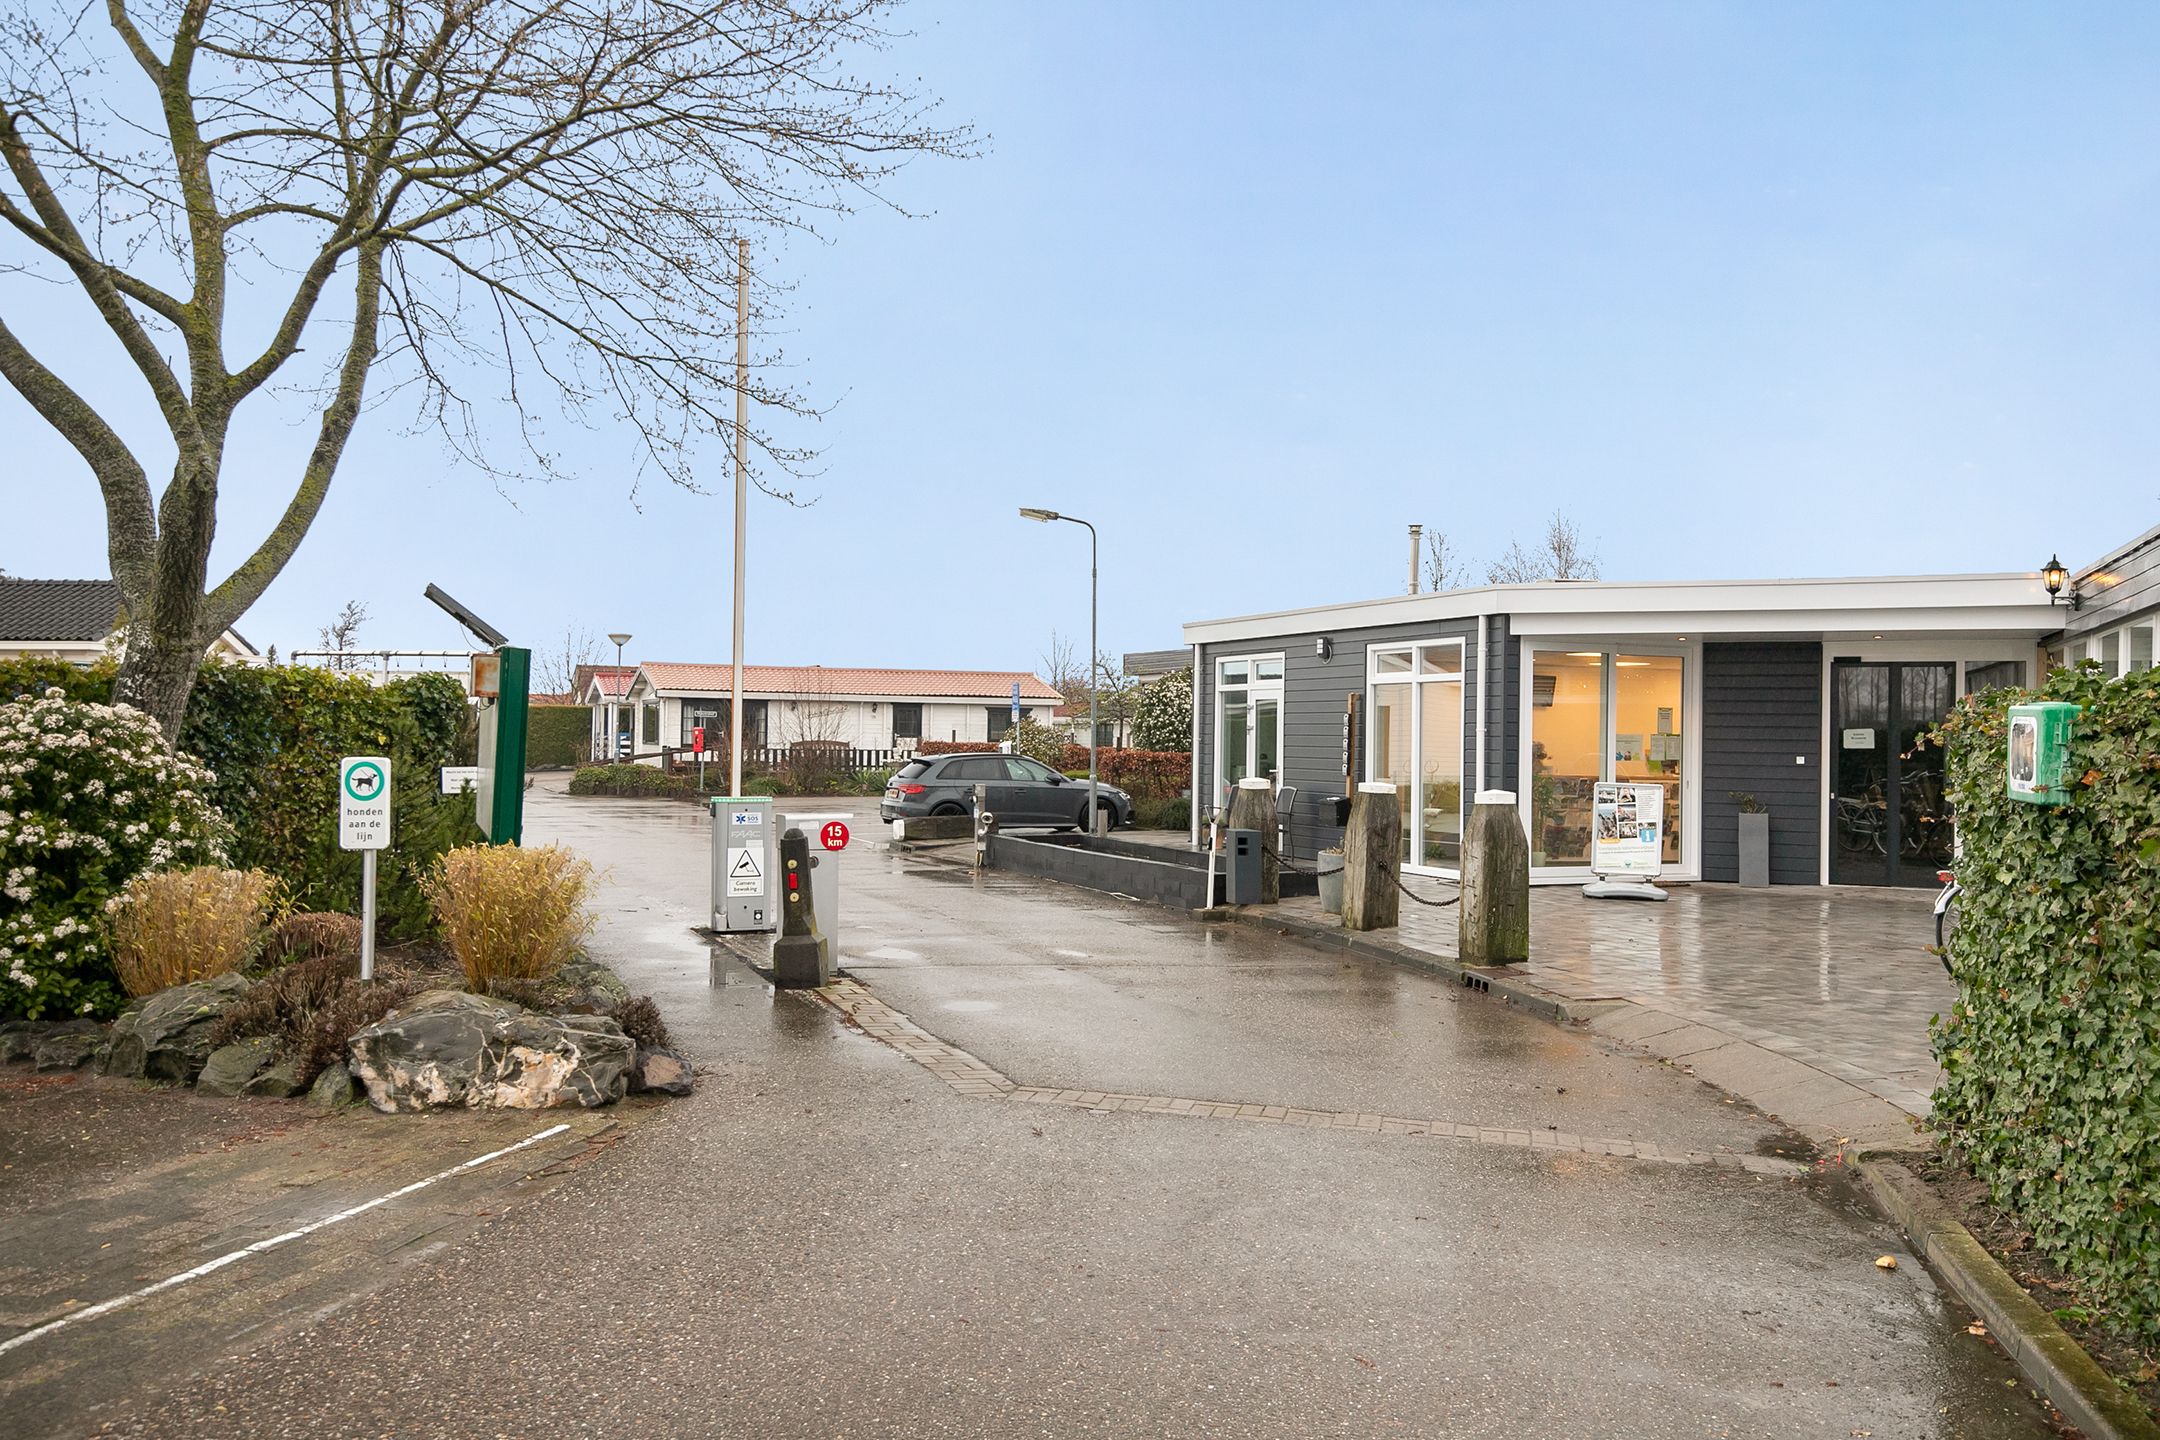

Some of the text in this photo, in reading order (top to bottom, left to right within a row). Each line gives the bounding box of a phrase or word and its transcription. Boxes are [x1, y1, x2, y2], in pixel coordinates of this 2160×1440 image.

[347, 808, 383, 816] honden
[369, 820, 381, 828] de
[731, 830, 761, 839] FAAC
[827, 825, 842, 837] 15
[357, 832, 373, 842] lijn
[827, 838, 843, 847] km
